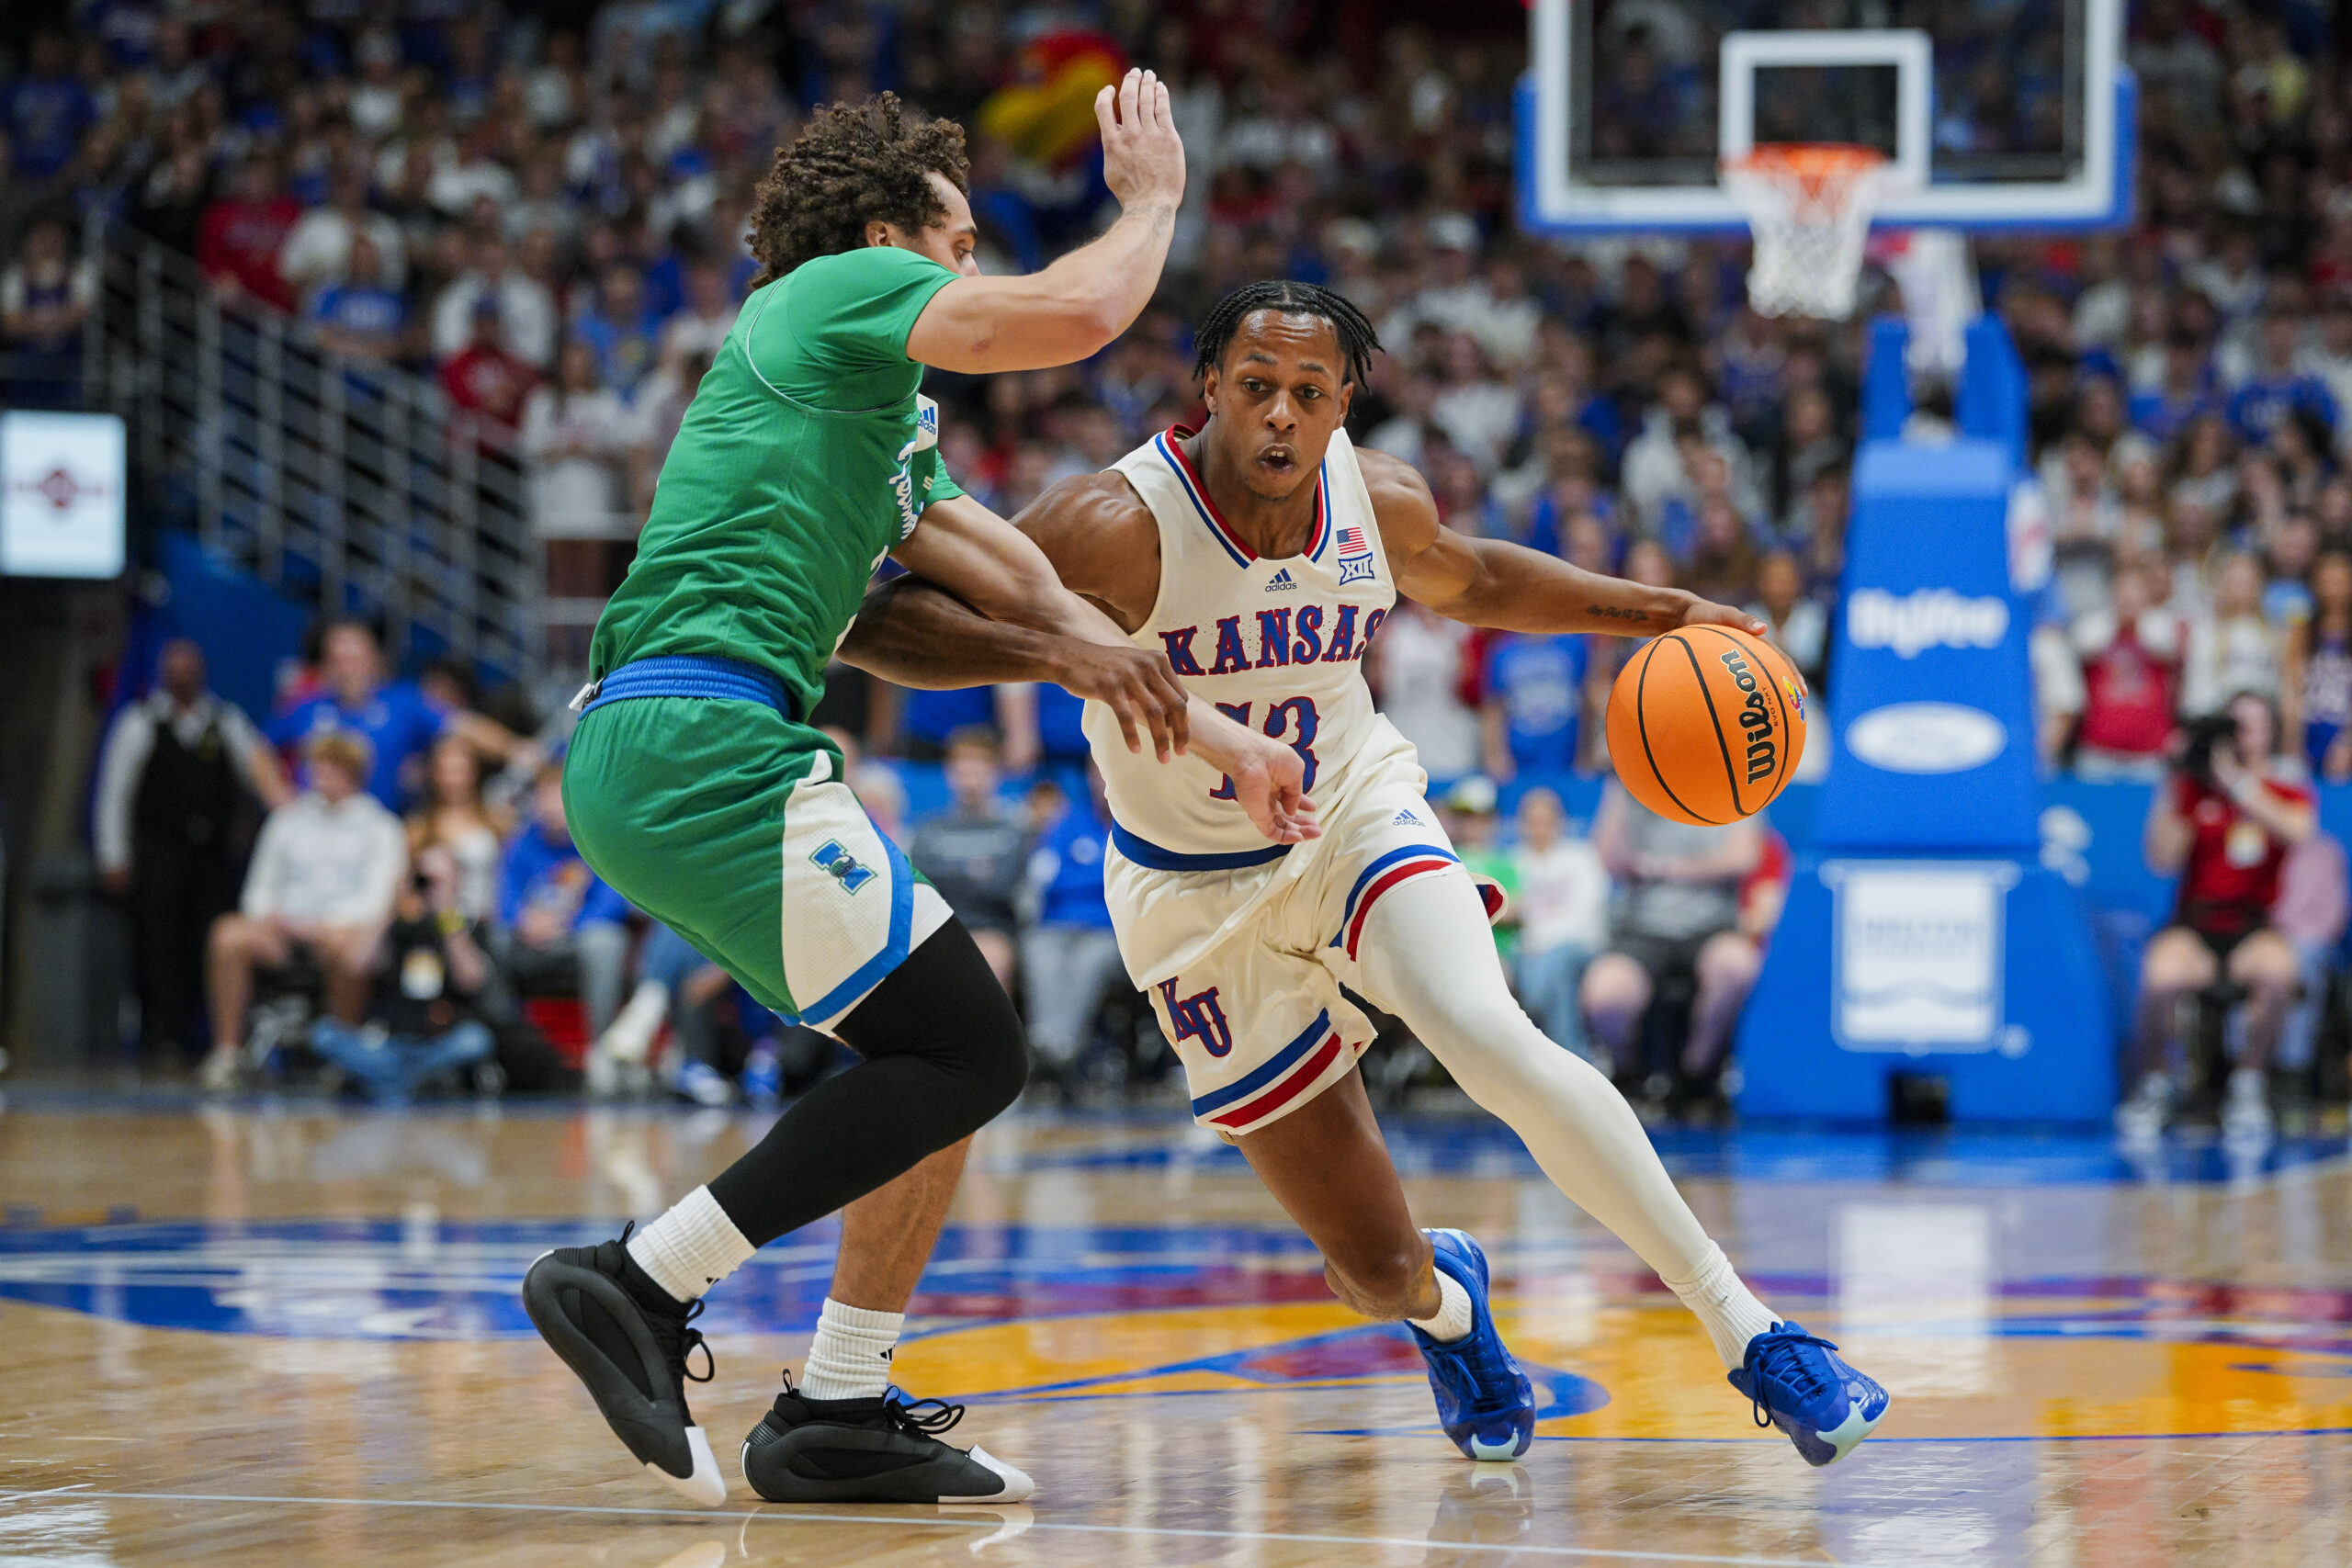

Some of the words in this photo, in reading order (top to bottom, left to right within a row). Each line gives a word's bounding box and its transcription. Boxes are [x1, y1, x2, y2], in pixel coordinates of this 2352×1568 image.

[1264, 581, 1297, 592] adidas
[1158, 604, 1389, 676] KANSAS
[1720, 649, 1776, 785] Wilson
[1157, 976, 1232, 1058] KU
